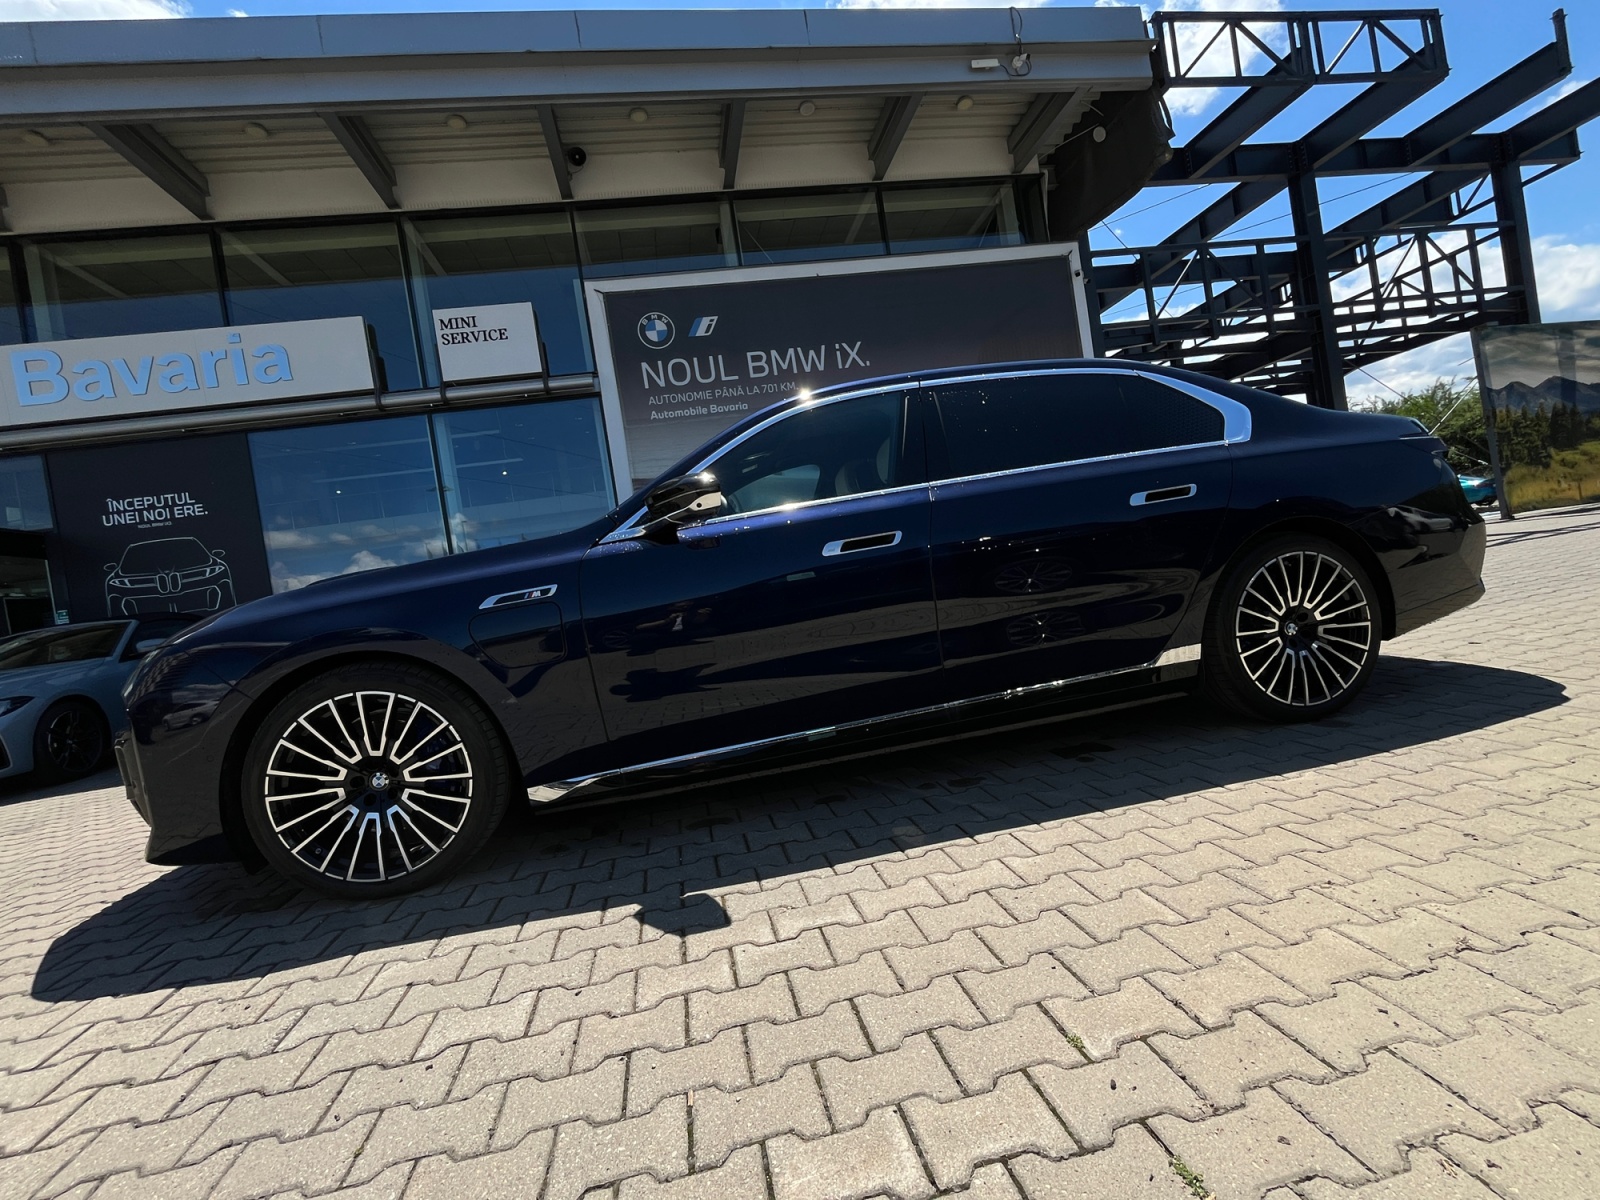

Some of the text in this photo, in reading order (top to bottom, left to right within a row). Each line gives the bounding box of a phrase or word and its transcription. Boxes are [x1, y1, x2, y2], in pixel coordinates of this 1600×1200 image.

[439, 316, 478, 331] MINI
[441, 328, 509, 346] SERVICE
[10, 332, 294, 407] Bavaria
[641, 341, 870, 389] NOUL BMW iX.
[648, 389, 713, 405] AUTONOMIE
[747, 386, 760, 396] LA
[762, 383, 778, 394] 701
[650, 402, 749, 420] Automobile Bavaria
[106, 492, 195, 512] ÎNCEPUTUL
[102, 511, 140, 526] UNEI
[143, 507, 170, 521] NOI
[173, 504, 208, 518] ERE.
